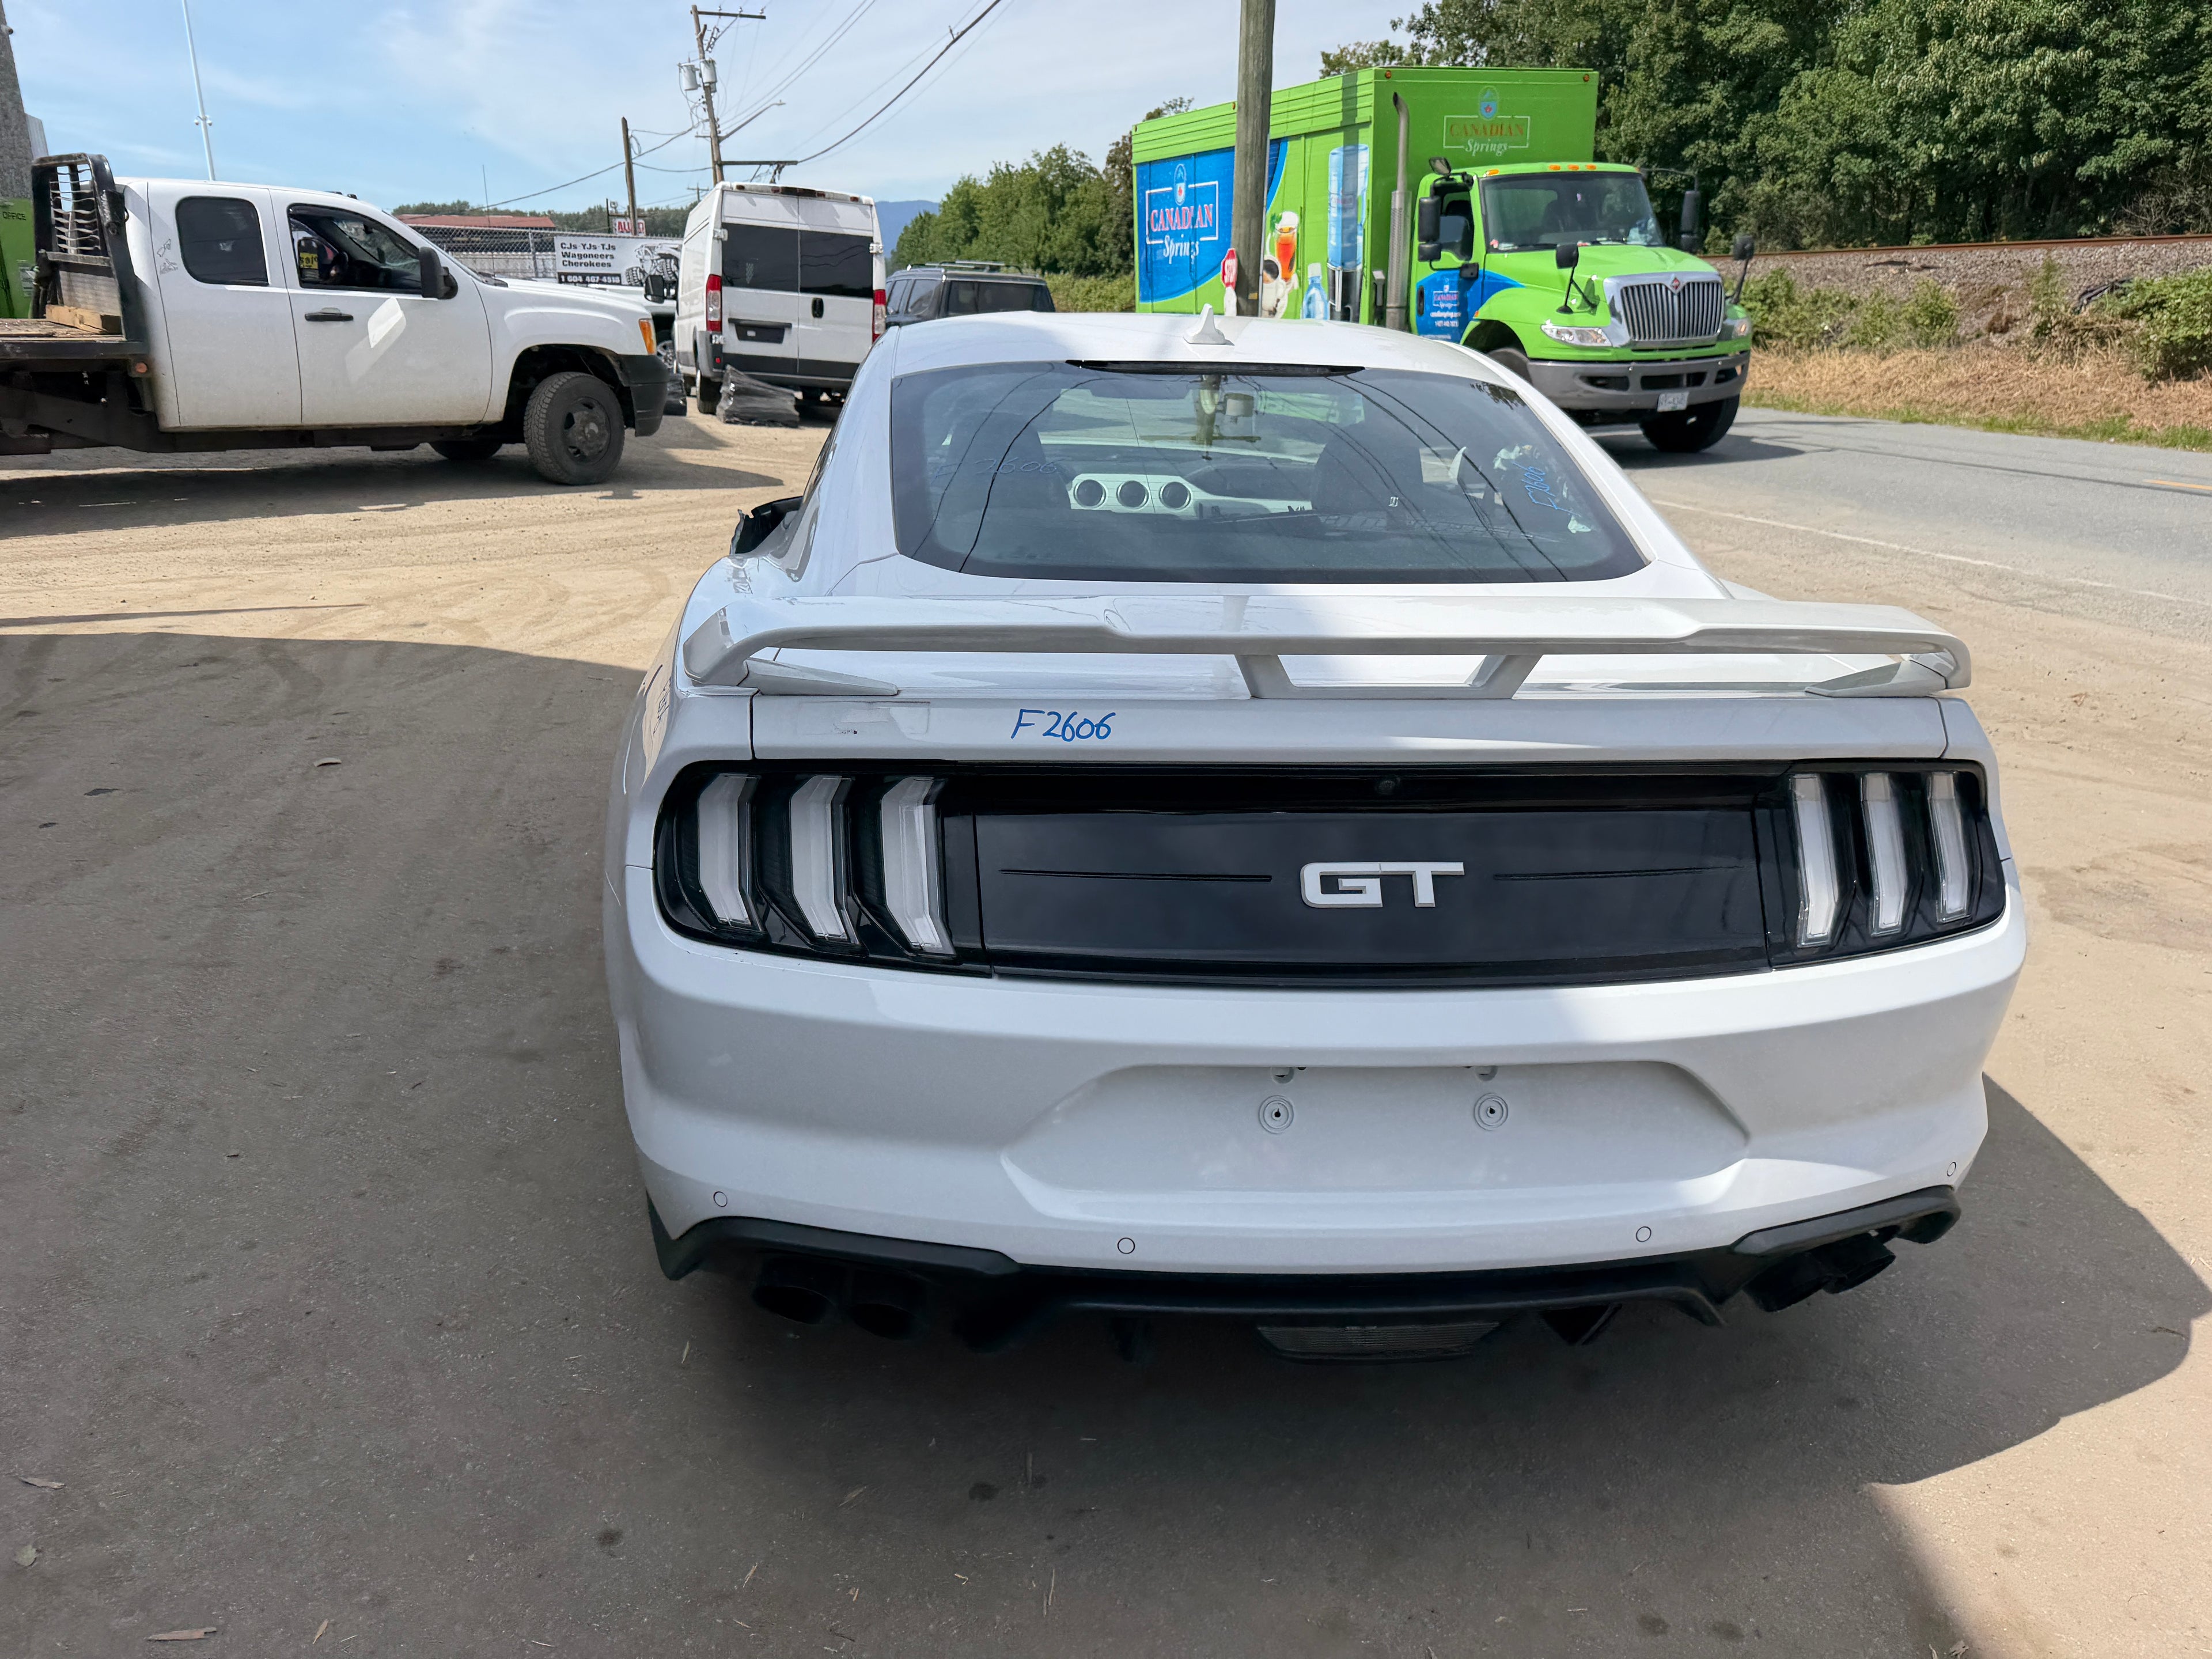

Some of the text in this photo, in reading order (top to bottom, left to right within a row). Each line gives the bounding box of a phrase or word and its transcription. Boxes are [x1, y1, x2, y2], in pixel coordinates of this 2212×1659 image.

[1450, 122, 1524, 137] CANADIAN
[1465, 138, 1508, 156] Springs
[618, 221, 645, 233] ALLD
[561, 251, 615, 260] Wagoneers
[562, 260, 612, 268] Cherokees
[1010, 709, 1116, 743] F2606
[1300, 862, 1465, 908] GT
